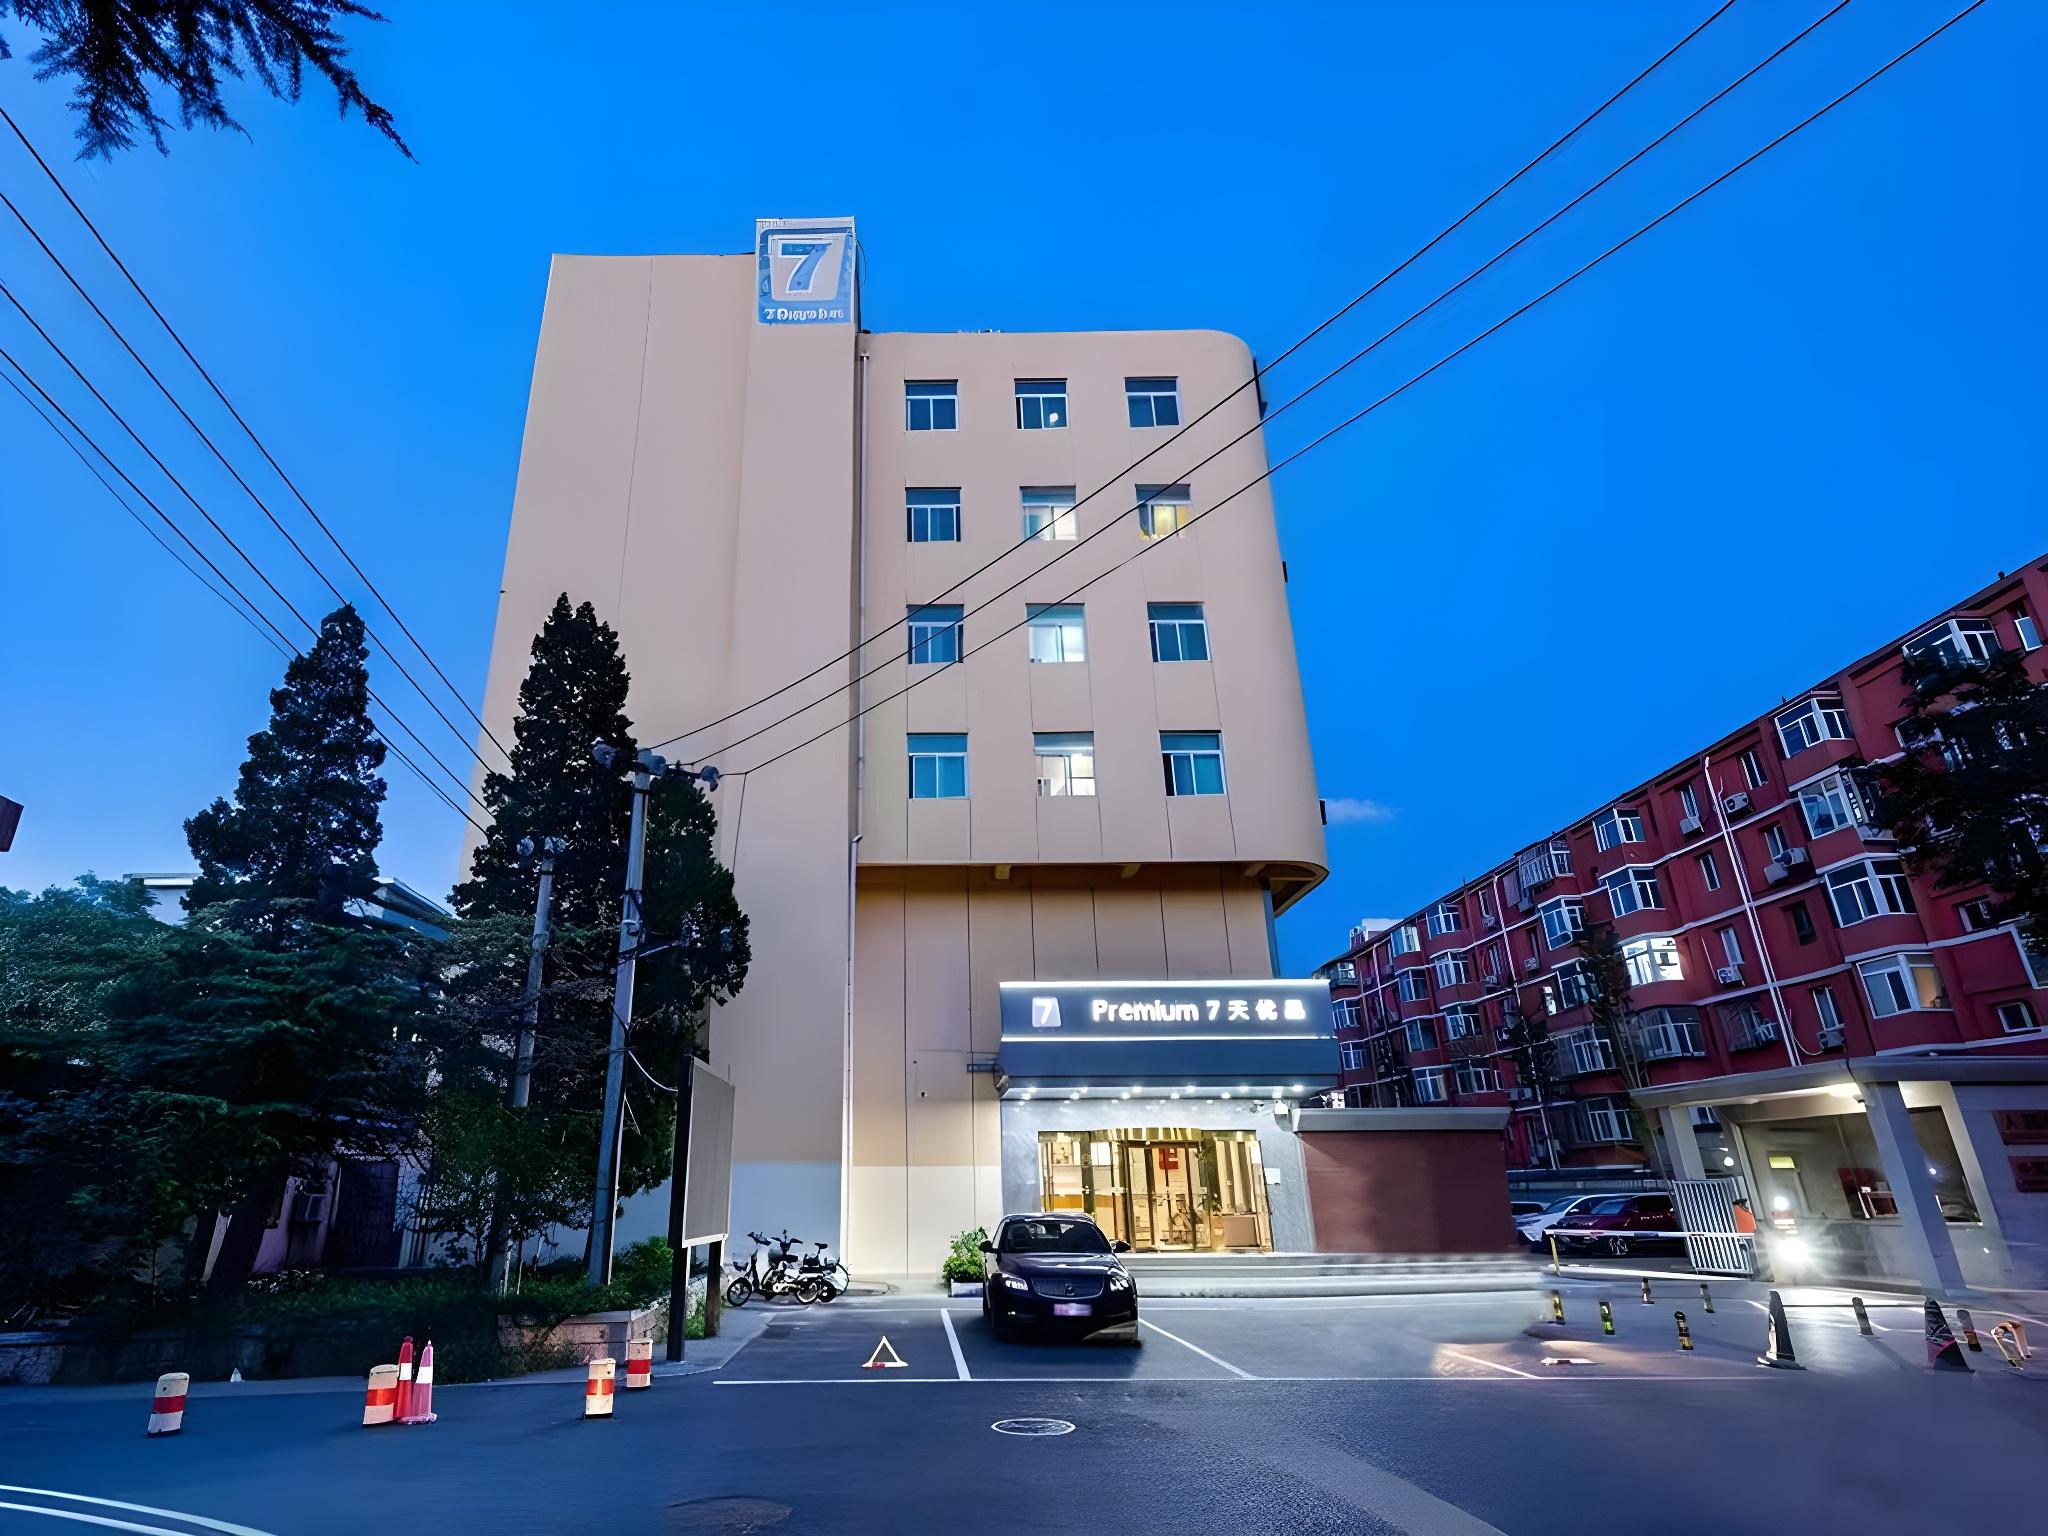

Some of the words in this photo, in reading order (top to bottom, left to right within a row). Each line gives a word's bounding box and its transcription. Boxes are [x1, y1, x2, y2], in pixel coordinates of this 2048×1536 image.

[778, 240, 832, 293] 7
[1035, 998, 1053, 1025] 7
[1092, 999, 1200, 1022] Premium
